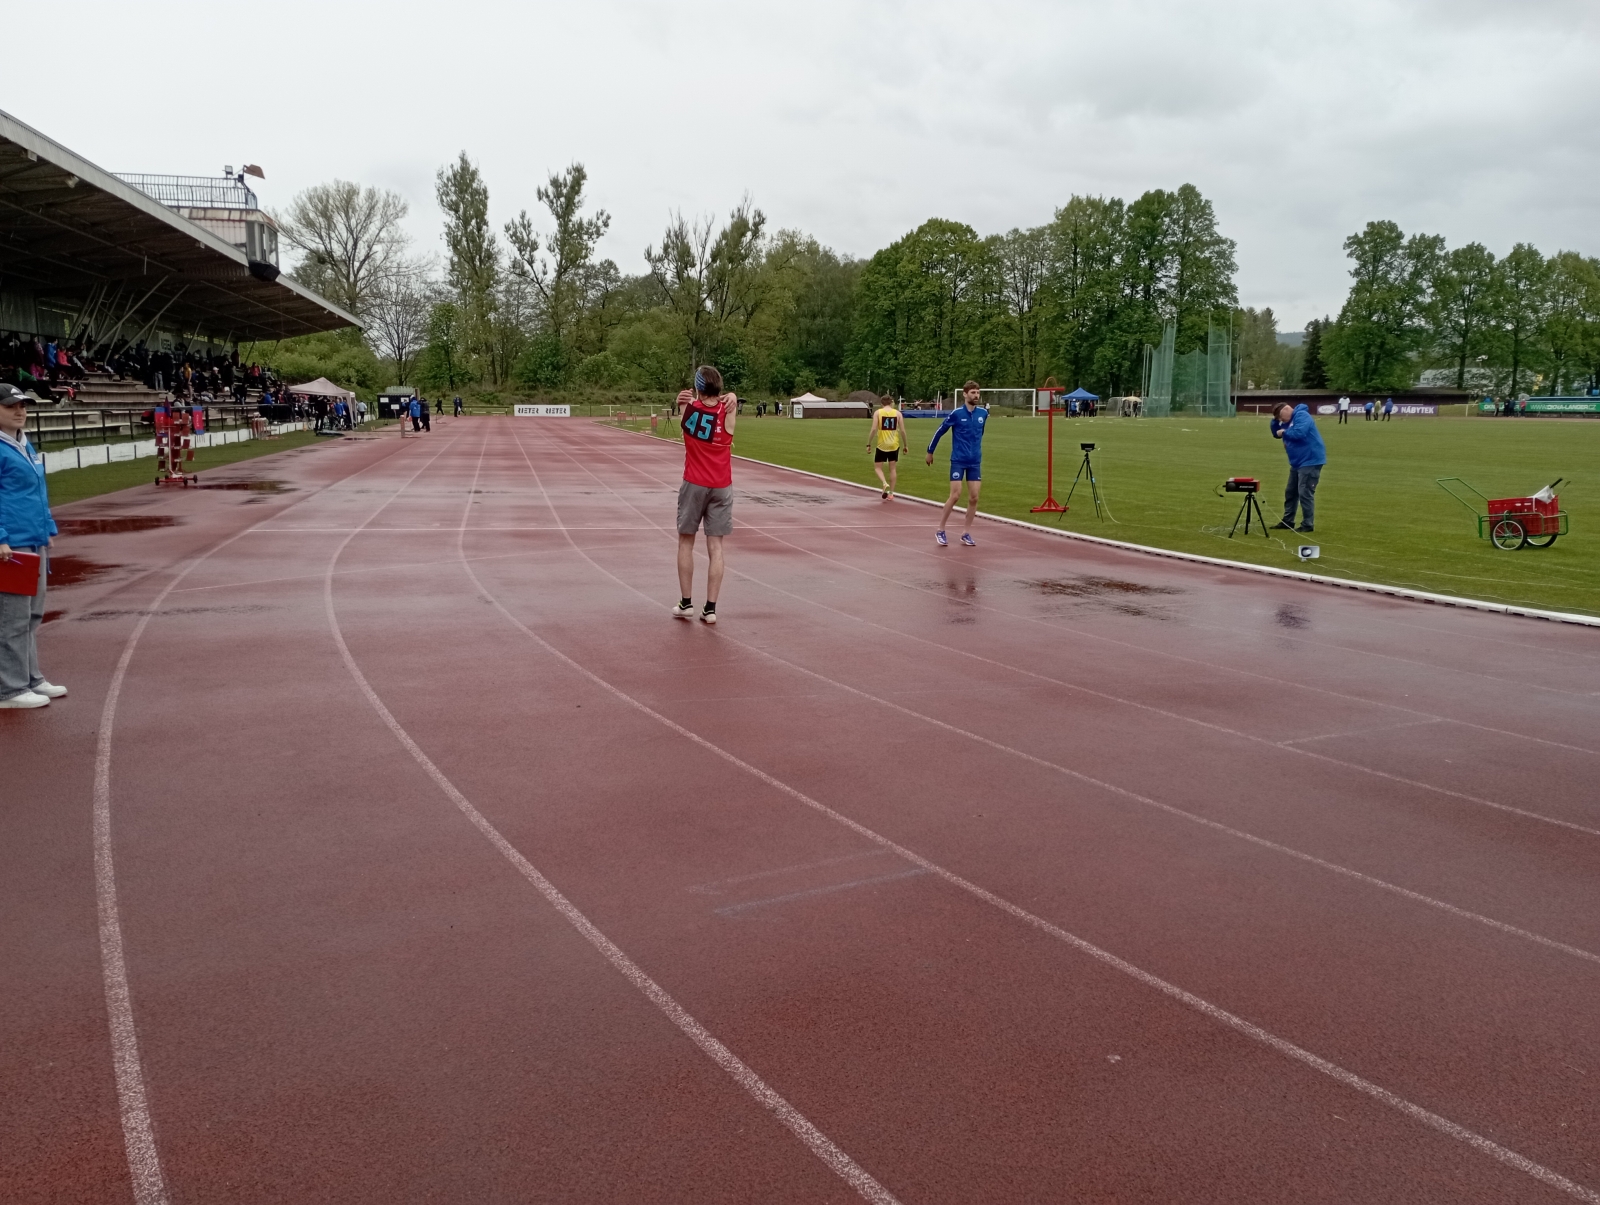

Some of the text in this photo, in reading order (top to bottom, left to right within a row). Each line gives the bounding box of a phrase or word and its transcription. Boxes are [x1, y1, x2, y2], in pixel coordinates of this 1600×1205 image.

[1401, 406, 1434, 414] NÁBYTEK
[685, 411, 714, 440] 45
[883, 417, 895, 429] 41
